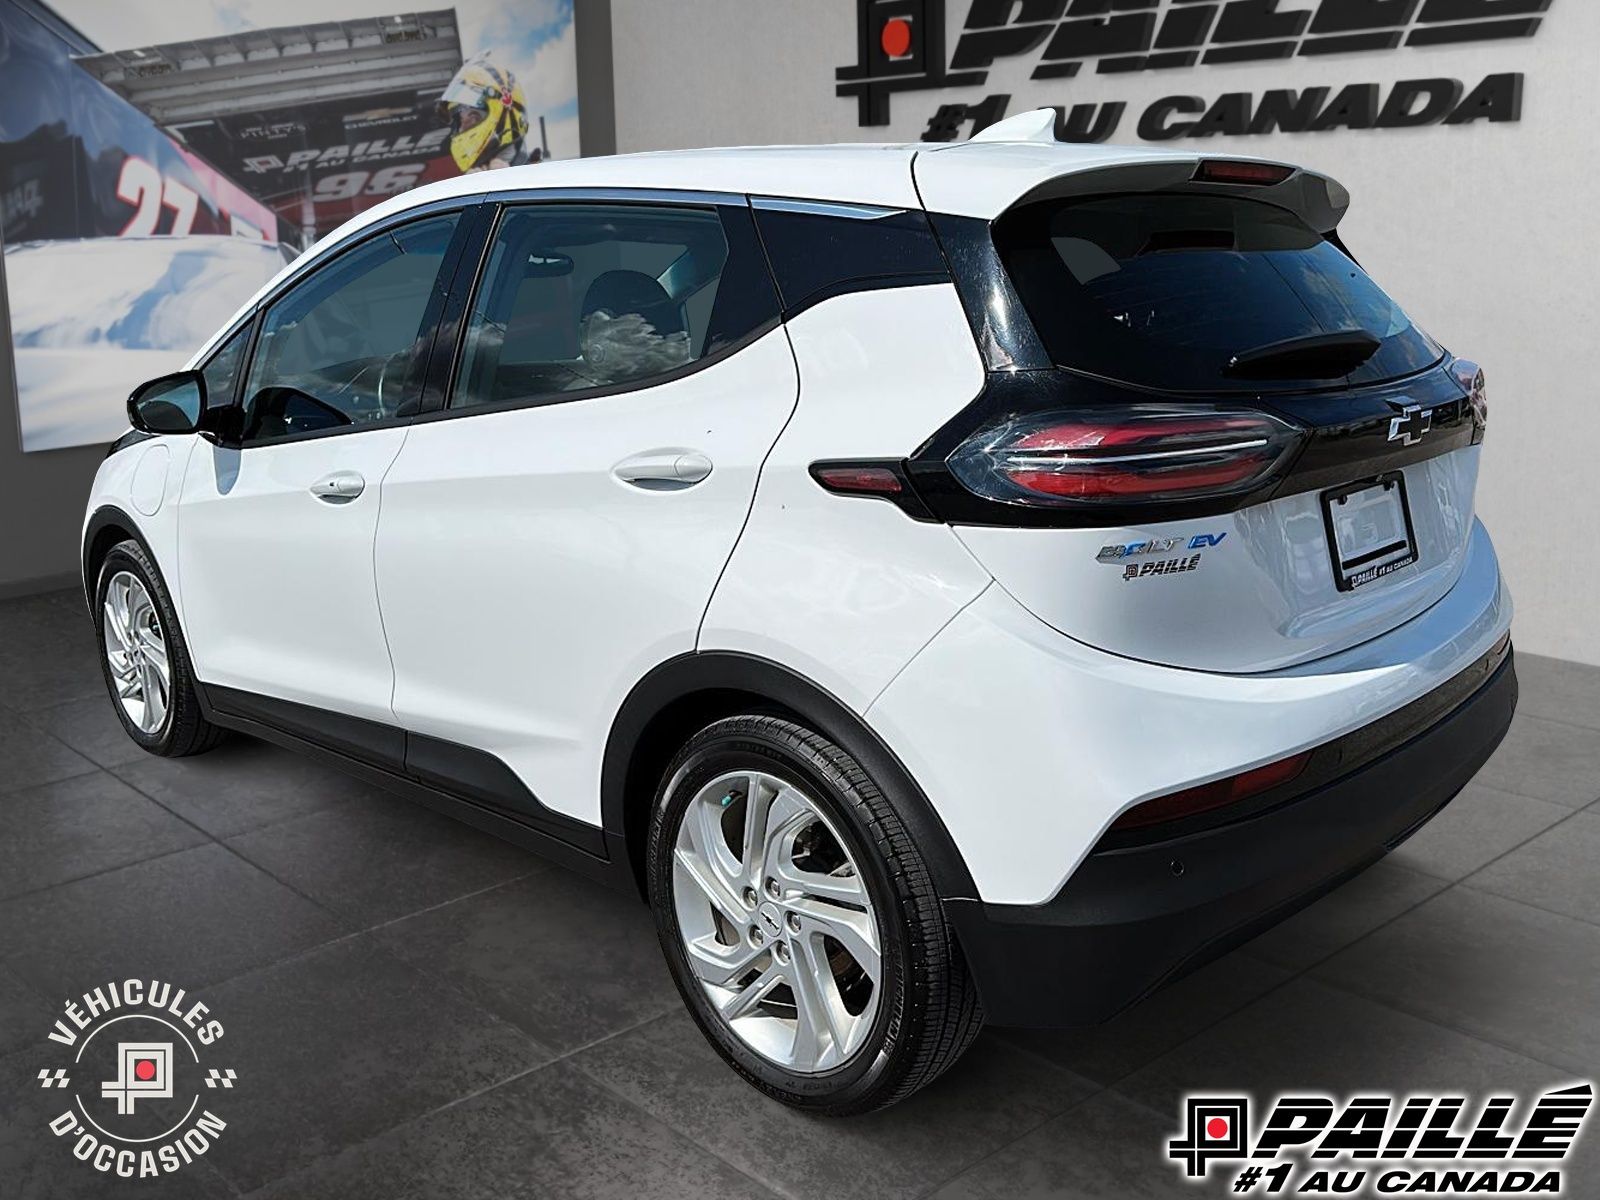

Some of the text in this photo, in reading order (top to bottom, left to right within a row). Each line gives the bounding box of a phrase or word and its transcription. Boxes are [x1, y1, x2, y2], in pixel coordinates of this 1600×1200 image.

[1136, 73, 1526, 142] CANADA
[311, 162, 427, 201] 96
[1187, 532, 1228, 550] EV
[1138, 553, 1202, 578] PAILLÉ
